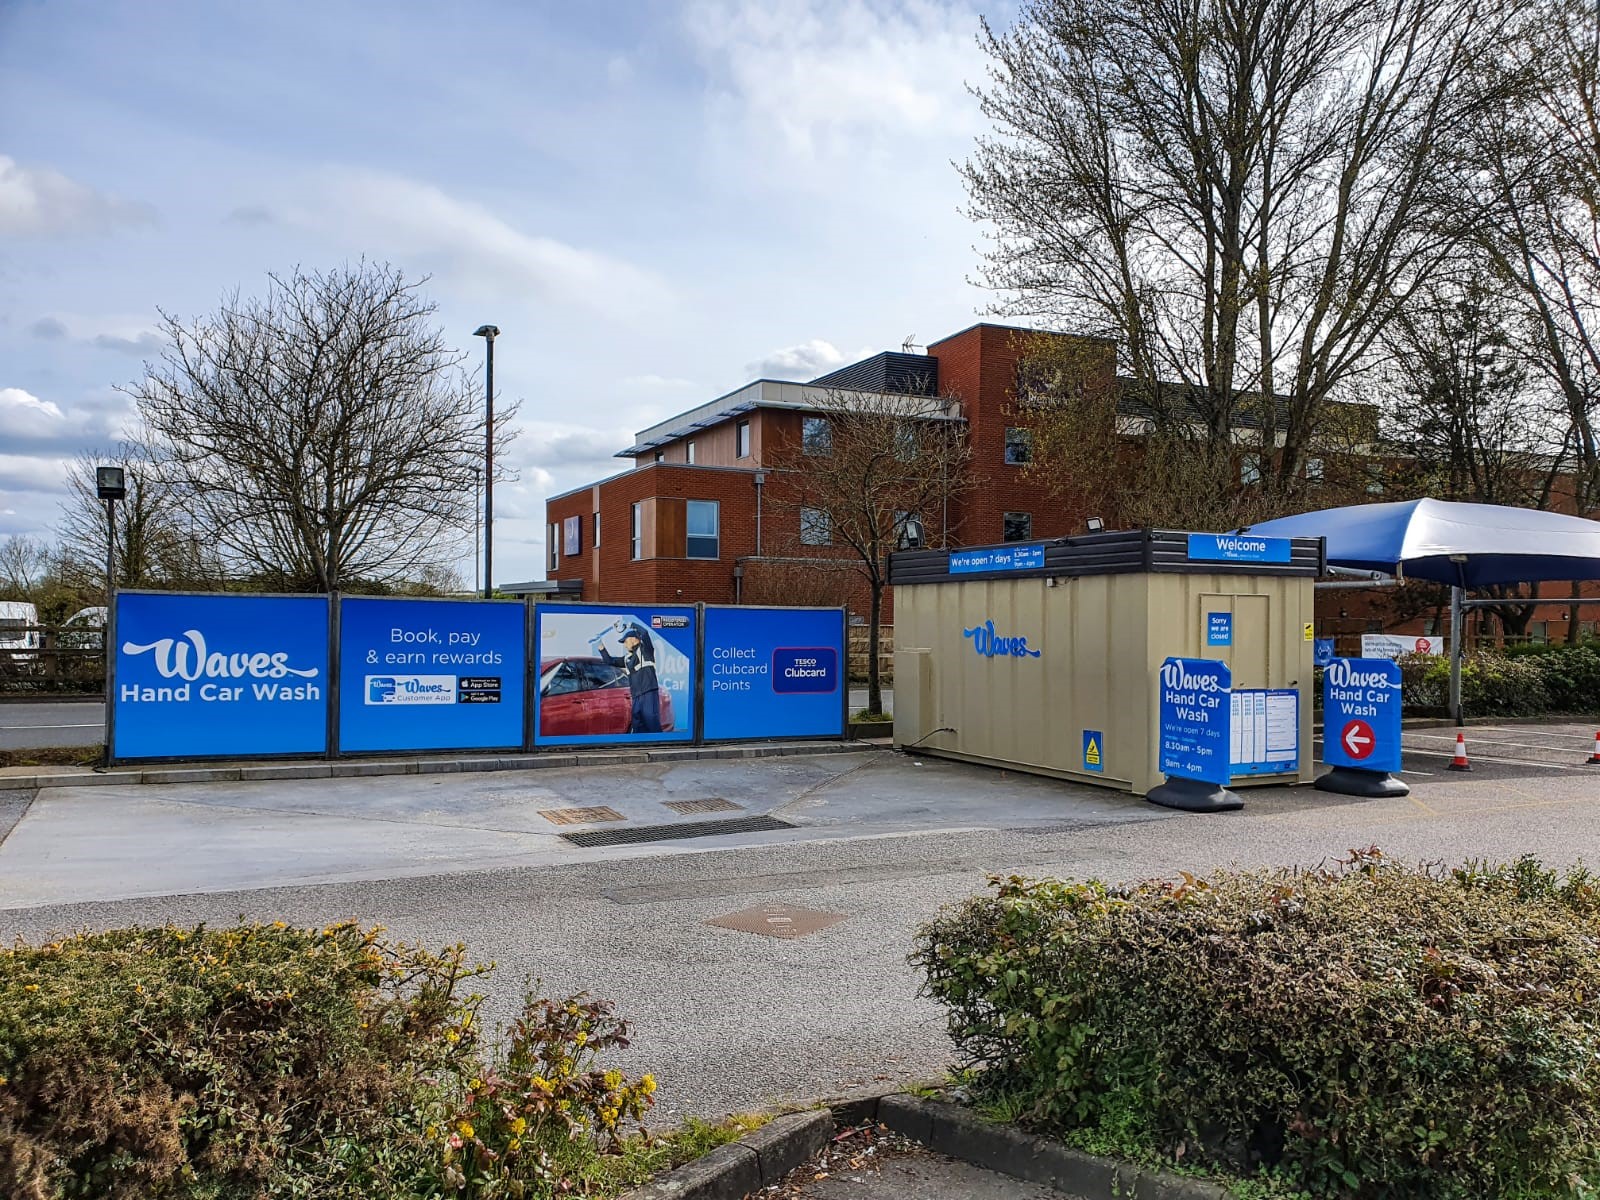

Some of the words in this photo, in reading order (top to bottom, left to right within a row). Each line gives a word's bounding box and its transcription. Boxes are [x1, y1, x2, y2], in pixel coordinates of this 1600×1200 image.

[1216, 539, 1266, 552] Welcome
[951, 557, 970, 567] We're
[971, 556, 988, 567] open
[990, 555, 994, 564] 7
[995, 554, 1011, 565] days
[1212, 617, 1227, 625] Sorry
[391, 628, 442, 644] Book,
[448, 632, 480, 646] pay
[963, 619, 1041, 658] Waves
[122, 629, 319, 681] Waves
[366, 649, 379, 664] &
[385, 652, 426, 664] earn
[432, 650, 502, 665] rewards
[712, 647, 756, 659] Collect
[712, 663, 768, 675] Clubcard
[794, 658, 817, 666] TESCO
[784, 667, 826, 678] Clubcard
[1159, 659, 1232, 694] Waves
[1323, 658, 1402, 690] Waves
[397, 678, 451, 694] Waves
[663, 678, 685, 691] Car
[712, 680, 751, 691] Points
[120, 683, 191, 703] Hand
[199, 683, 244, 702] Car
[252, 682, 320, 702] Wash
[435, 694, 451, 703] App
[1165, 690, 1195, 706] Hand
[1198, 694, 1220, 708] Car
[1330, 688, 1363, 701] Hand
[1366, 690, 1390, 703] Car
[1176, 706, 1209, 723] Wash
[1340, 702, 1377, 717] Wash
[1165, 723, 1182, 732] We're
[1183, 727, 1199, 735] open
[1205, 729, 1221, 738] days
[1165, 740, 1190, 753] 8.30am
[1196, 746, 1213, 756] 5pm
[1165, 758, 1180, 768] 9am
[1186, 762, 1202, 773] 4pm
